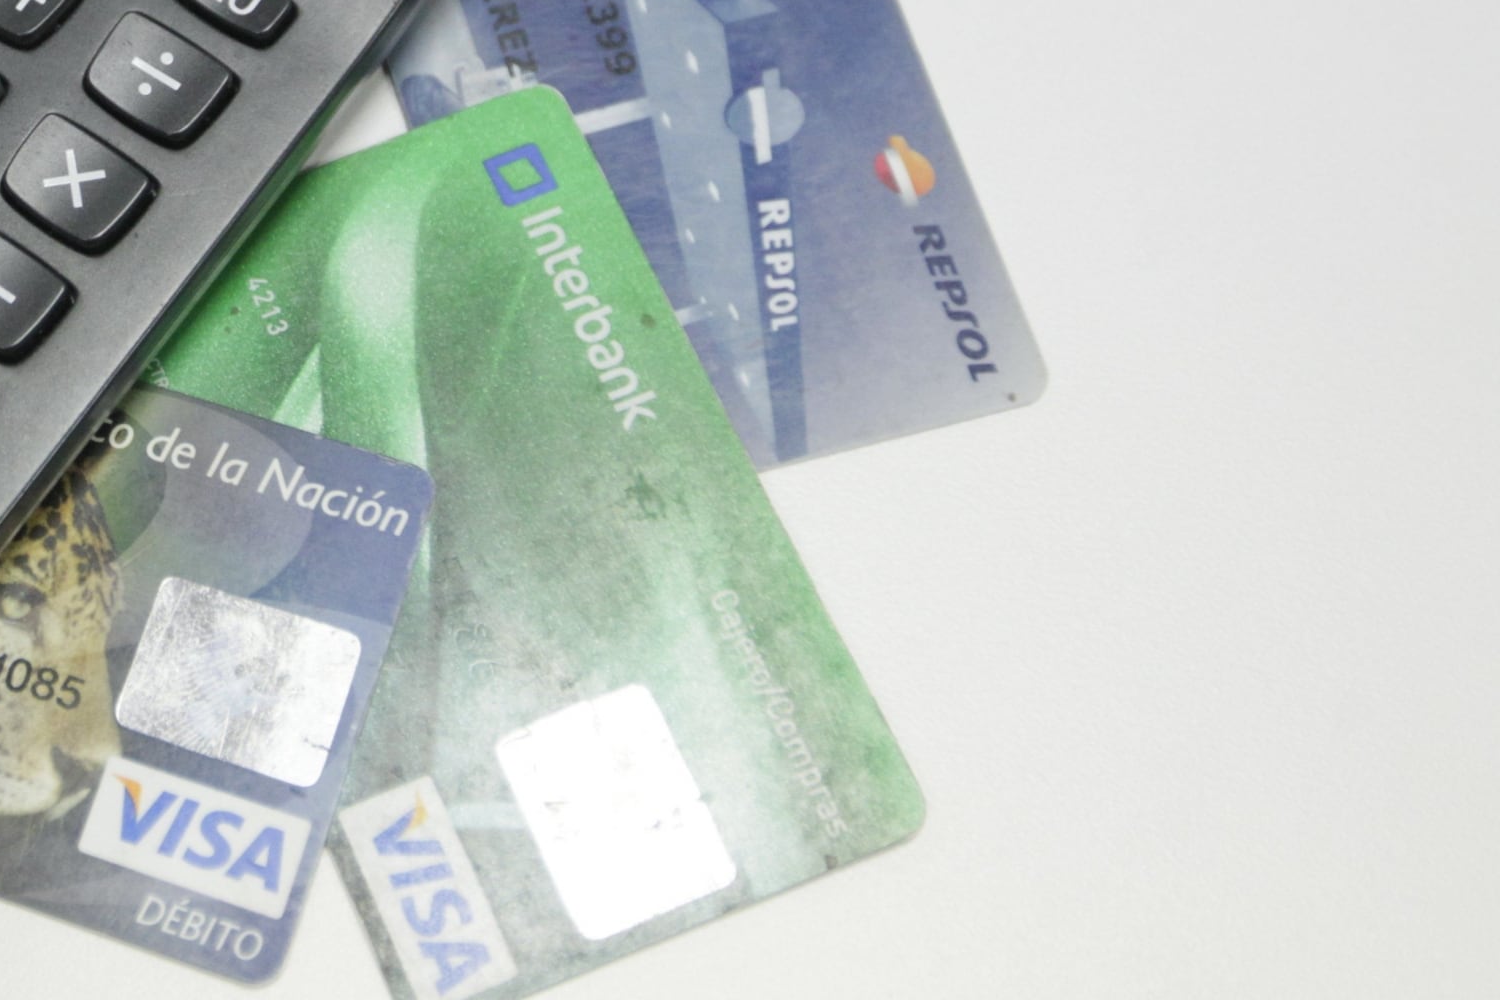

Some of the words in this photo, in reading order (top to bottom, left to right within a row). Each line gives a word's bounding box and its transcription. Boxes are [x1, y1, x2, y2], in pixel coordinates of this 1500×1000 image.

[248, 278, 288, 335] 4213
[522, 205, 657, 431] Interbank
[757, 199, 798, 332] REPSOL
[912, 223, 998, 384] REPSOL
[146, 427, 196, 469] de
[206, 442, 248, 486] la
[257, 457, 409, 537] Nación
[114, 775, 286, 893] VISA
[373, 790, 493, 998] VISA
[135, 893, 263, 962] DÉBITO
